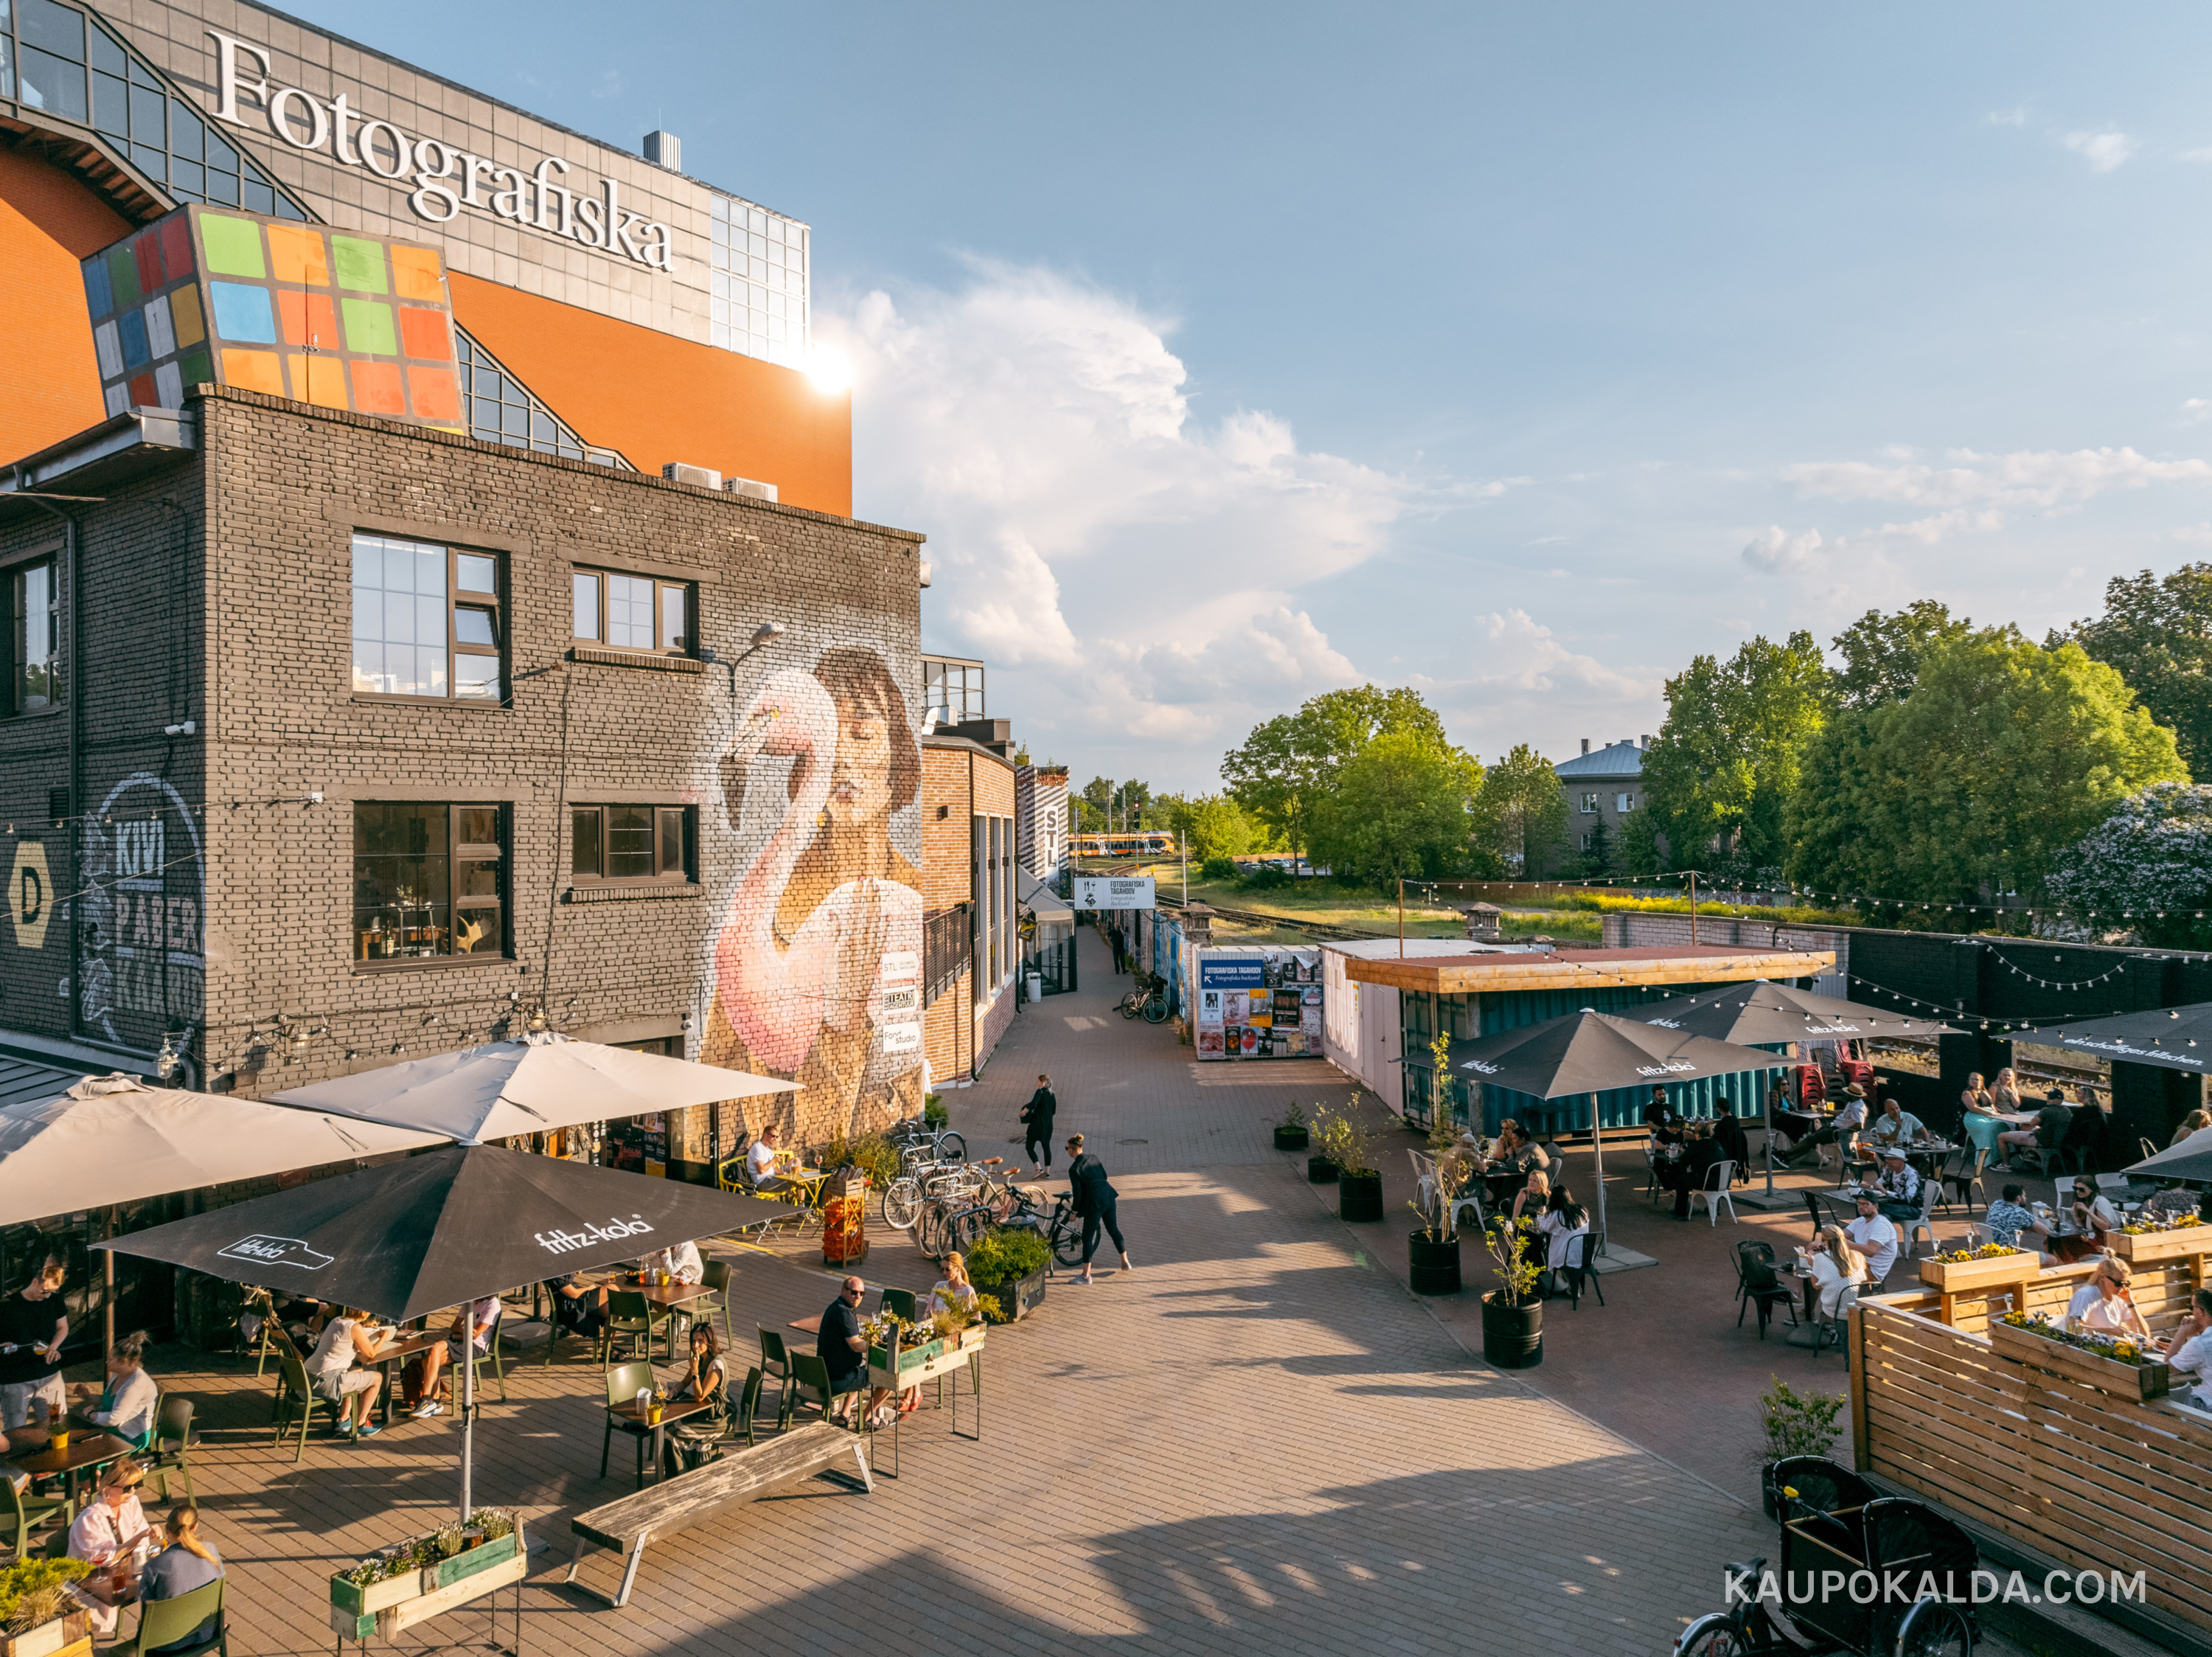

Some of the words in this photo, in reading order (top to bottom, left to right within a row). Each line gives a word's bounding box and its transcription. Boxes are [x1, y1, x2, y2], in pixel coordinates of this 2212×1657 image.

[209, 29, 677, 272] Fotografiska
[116, 821, 164, 876] KIVI
[1046, 810, 1057, 868] STL
[21, 866, 42, 924] D
[116, 894, 199, 952] PABER
[884, 962, 897, 972] STL
[889, 990, 914, 1003] TEATRI
[890, 1001, 914, 1010] AGENTUUR
[895, 1034, 917, 1044] studio
[534, 1215, 655, 1254] fritz-kola
